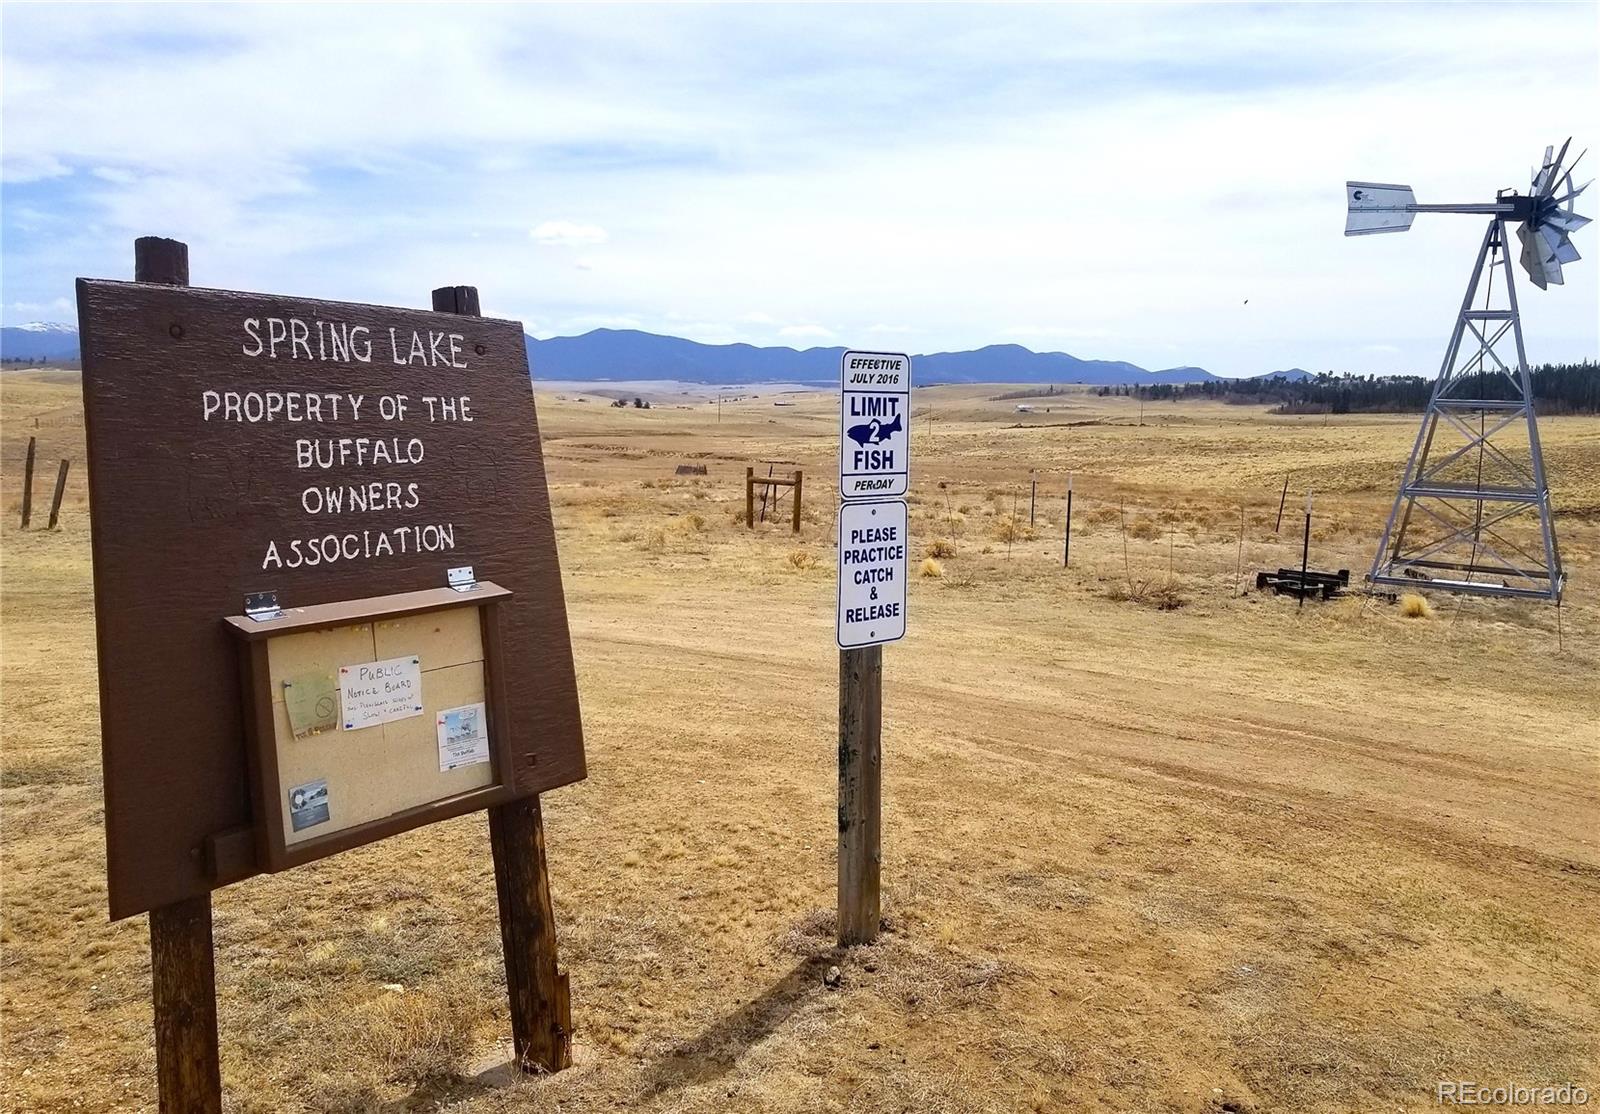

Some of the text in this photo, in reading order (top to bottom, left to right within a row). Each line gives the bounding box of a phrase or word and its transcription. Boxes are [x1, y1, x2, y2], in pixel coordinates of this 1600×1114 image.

[242, 317, 467, 368] SPRING LAKE
[850, 358, 902, 370] EFFECTIVE
[850, 373, 899, 384] JULY 2016
[202, 390, 474, 422] PROPERTY OF THE
[851, 396, 899, 416] LIMIT
[868, 421, 880, 442] 2
[296, 437, 424, 468] BUFFALO
[854, 450, 894, 470] FISH
[854, 479, 895, 491] PER DAY
[302, 482, 420, 514] OWNERS
[851, 526, 897, 544] PLEASE
[262, 523, 456, 569] ASSOCIATION
[844, 545, 903, 565] PRACTICE
[854, 567, 893, 585] CATCH
[869, 586, 878, 600] &
[846, 602, 900, 623] RELEASE
